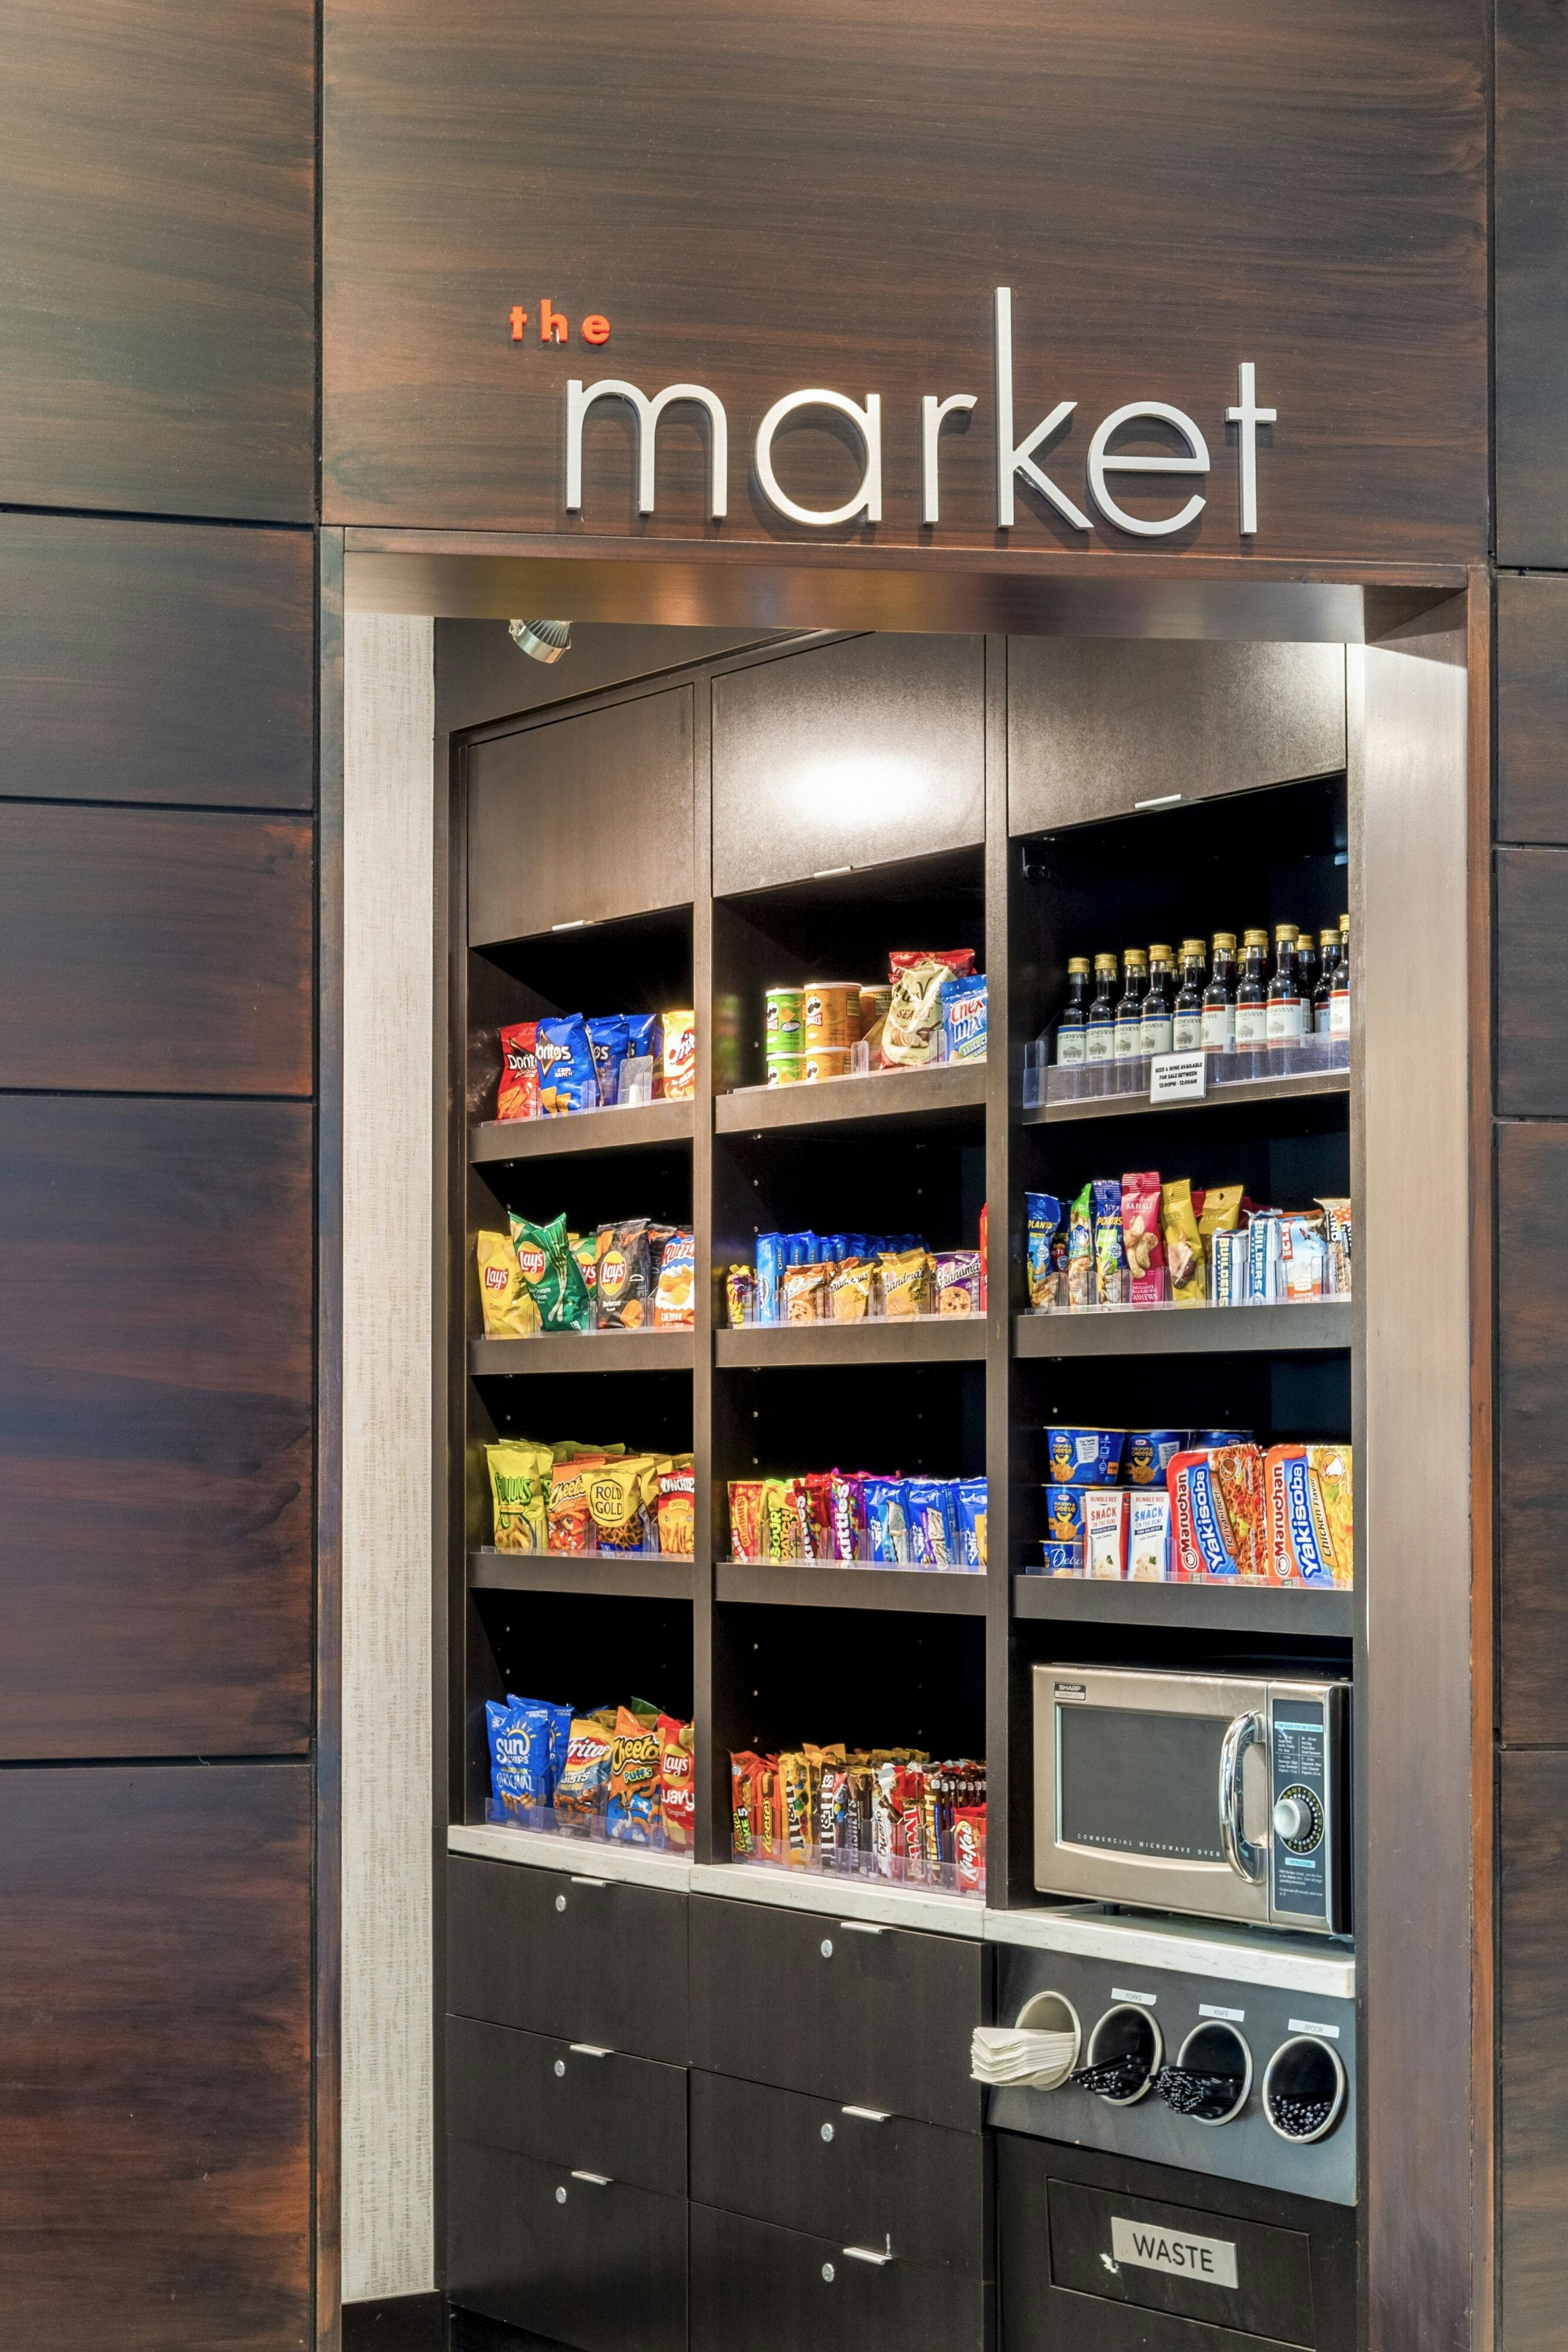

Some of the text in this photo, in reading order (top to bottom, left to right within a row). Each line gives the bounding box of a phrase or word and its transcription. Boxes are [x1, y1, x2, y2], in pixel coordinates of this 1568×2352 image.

[509, 299, 611, 345] the
[566, 287, 1278, 537] market
[896, 1008, 913, 1020] SEA
[950, 997, 984, 1024] Chex
[506, 1054, 537, 1070] Dorit
[1181, 1062, 1203, 1070] AVAILABLE
[1125, 1202, 1154, 1210] SAHALE
[520, 1251, 543, 1274] Lay's
[662, 1242, 695, 1264] RUFFL
[486, 1267, 508, 1290] Lay's
[602, 1261, 624, 1285] Lay's
[596, 1486, 622, 1500] ROLD
[660, 1477, 695, 1494] UNCHIE
[596, 1501, 623, 1515] GOLD
[1091, 1506, 1117, 1521] SNACK
[1178, 1474, 1189, 1553] Maruchan
[1215, 1491, 1224, 1513] Beef
[1272, 1466, 1284, 1557] Maruchan
[1135, 1506, 1164, 1522] SNACK
[1195, 1470, 1225, 1572] Yakisoba
[1293, 1466, 1320, 1578] Yakisoba
[1309, 1478, 1332, 1557] Chicken Flavor
[769, 1511, 782, 1559] SOUR
[780, 1508, 791, 1561] PATCH
[1220, 1513, 1234, 1548] Teriyaki
[496, 1738, 530, 1765] Sun
[507, 1755, 529, 1765] CHIPS
[612, 1734, 660, 1771] Cheeto
[663, 1753, 689, 1777] Lay's
[496, 1772, 535, 1792] ORIGINAL
[737, 1807, 754, 1852] TAKE 5
[1078, 1833, 1221, 1857] COMMERCIAL MICROWAVE OVEN
[1125, 1992, 1142, 2002] FORKS
[1214, 2009, 1229, 2018] KNIFE
[1303, 2024, 1323, 2033] SPOON
[1132, 2233, 1214, 2274] WASTE
